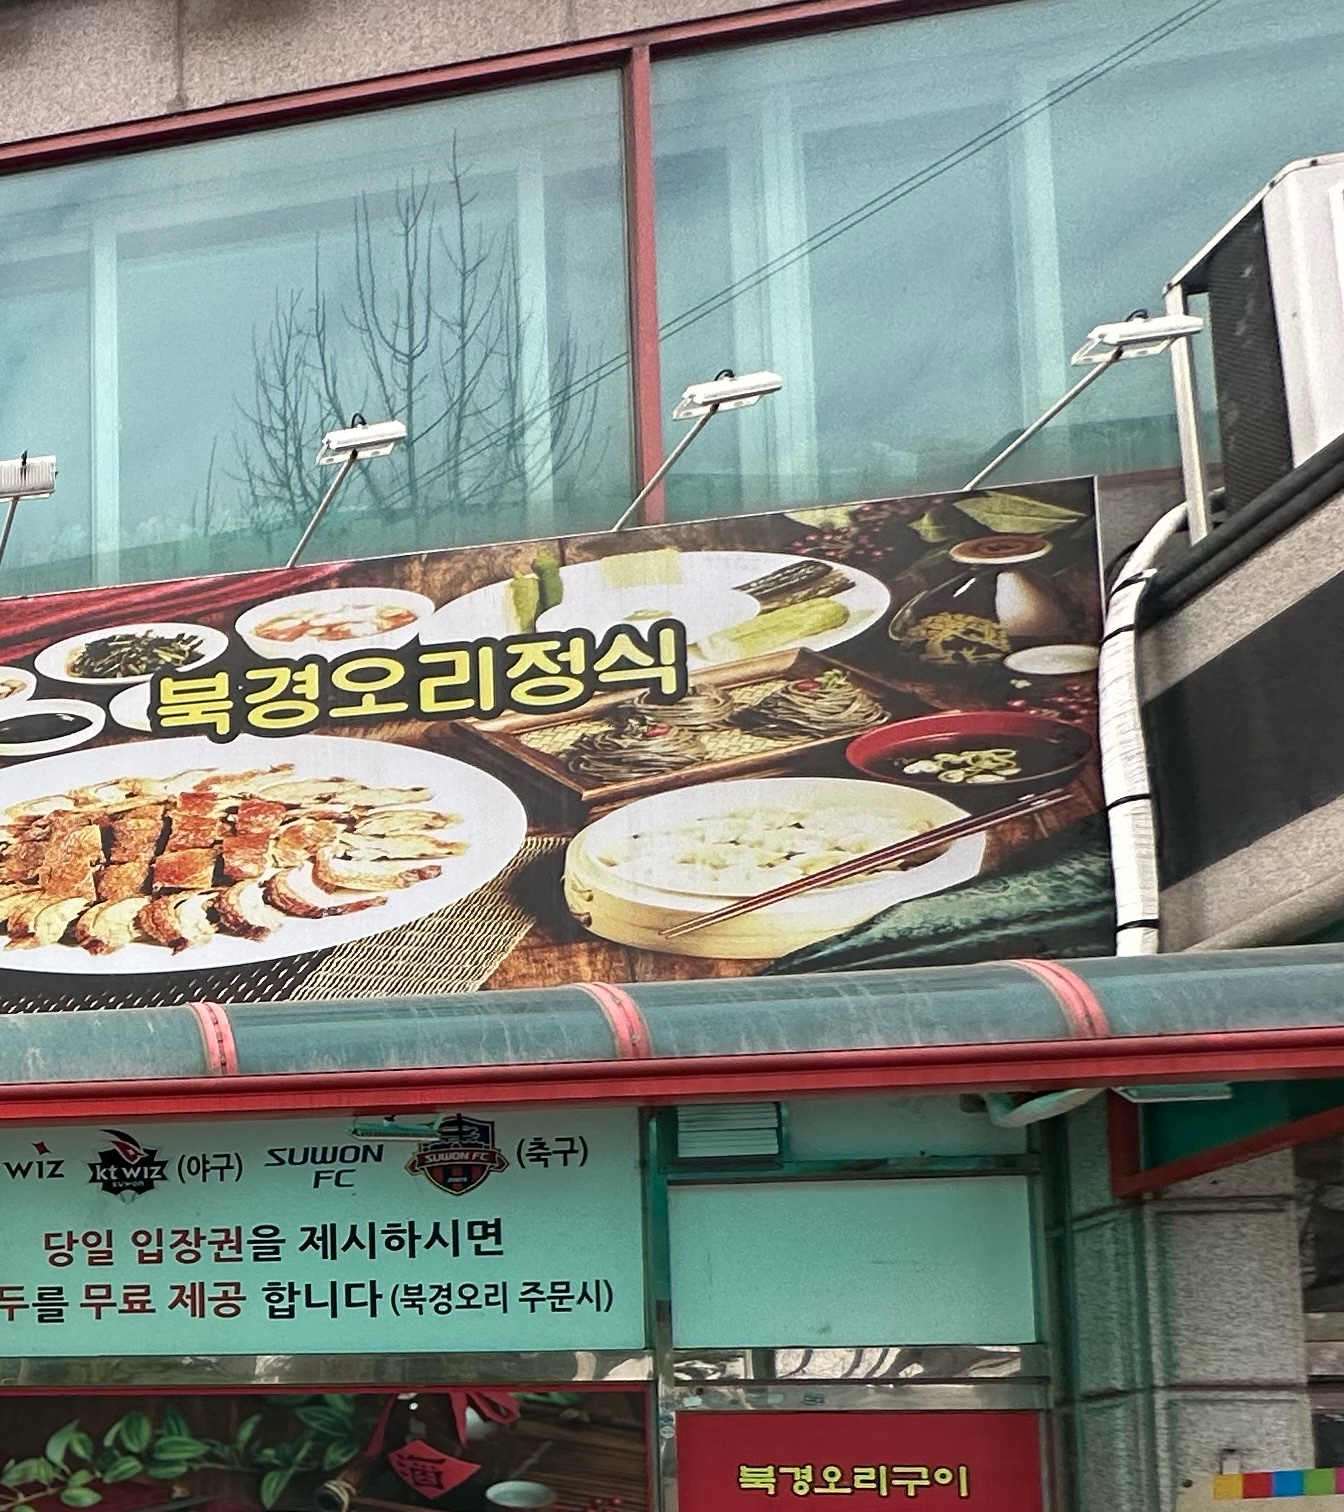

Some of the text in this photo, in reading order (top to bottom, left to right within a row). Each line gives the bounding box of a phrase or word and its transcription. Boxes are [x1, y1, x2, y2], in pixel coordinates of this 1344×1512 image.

[154, 626, 686, 738] 북경오리정식
[177, 1152, 244, 1184] (야구)
[264, 1143, 385, 1168] SUWON
[425, 1150, 469, 1162] SUWON
[516, 1135, 589, 1169] (축구)
[312, 1168, 357, 1189] FC
[43, 1217, 506, 1268] 당일 입장권을 제시하시면
[79, 1282, 158, 1319] 무료
[168, 1281, 247, 1319] 제공
[261, 1280, 383, 1319] 합니다
[390, 1281, 510, 1318] (북경오리
[517, 1277, 614, 1314] 주문시)
[738, 1464, 969, 1498] 북경오리구이
